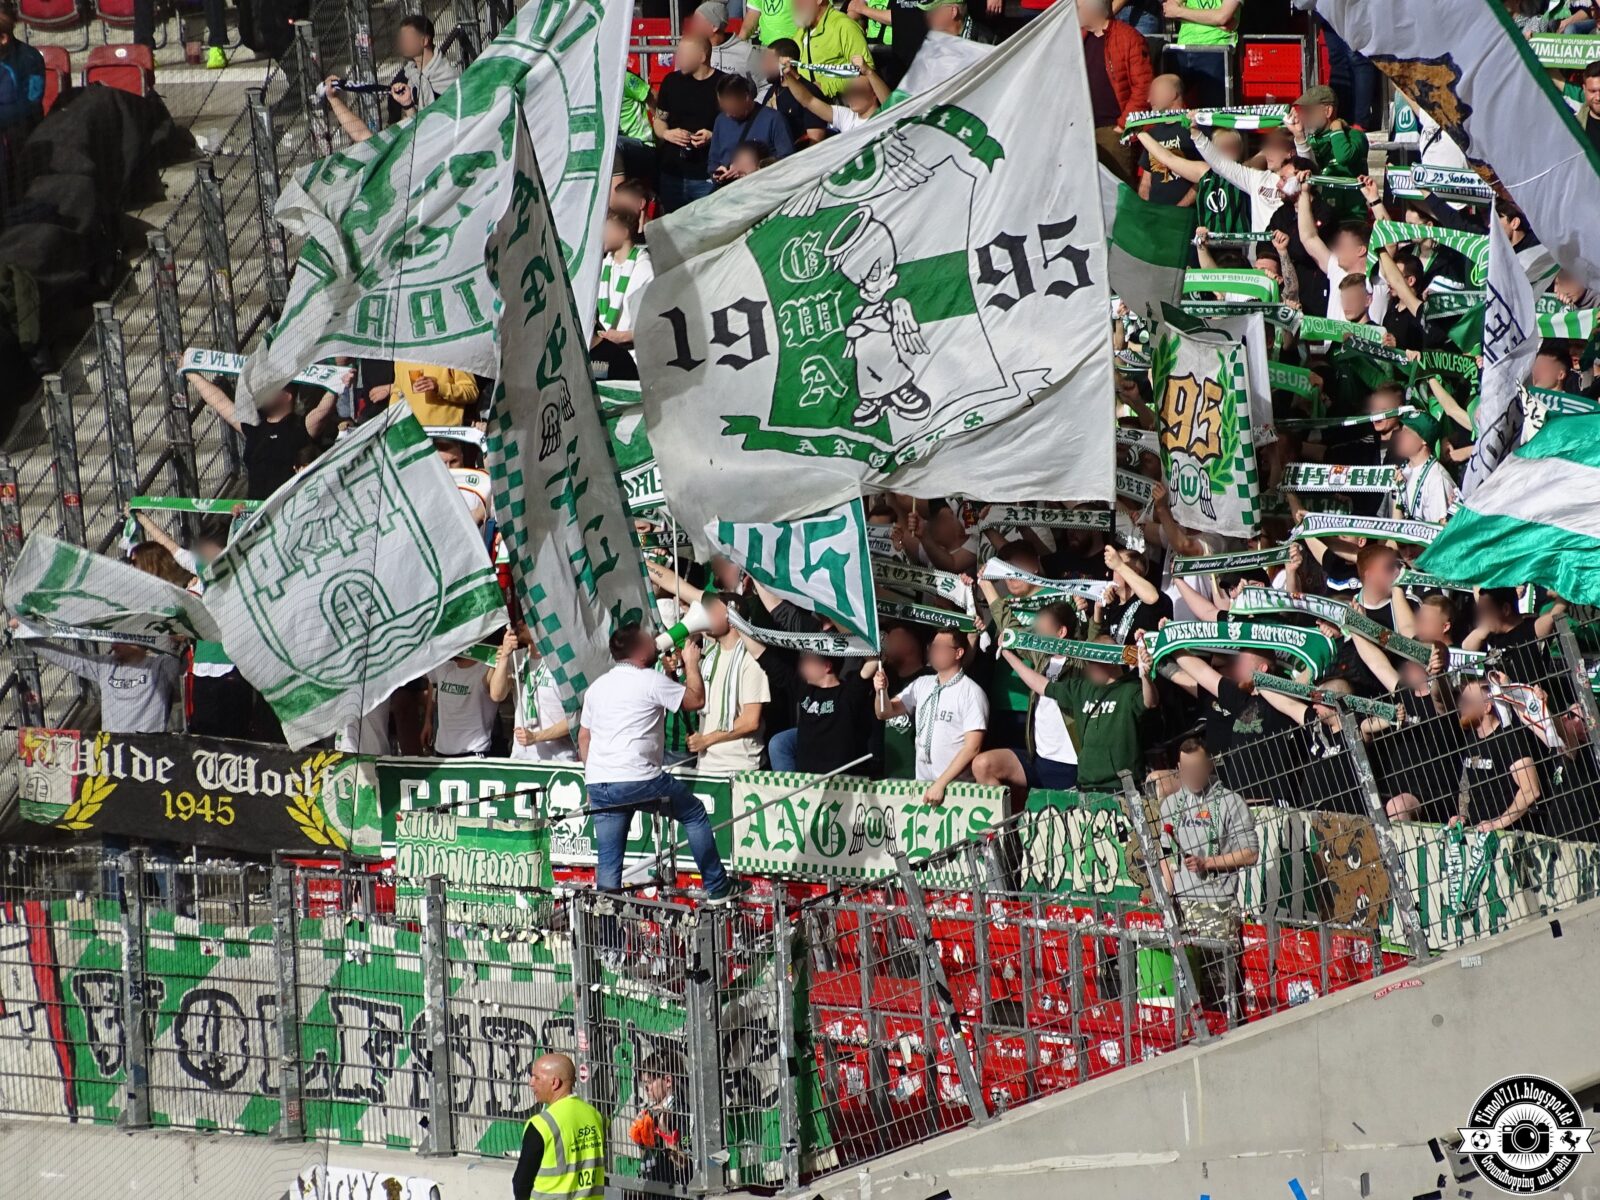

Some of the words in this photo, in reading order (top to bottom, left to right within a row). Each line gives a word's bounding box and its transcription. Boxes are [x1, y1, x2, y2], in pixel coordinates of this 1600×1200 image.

[659, 297, 772, 372] 19
[975, 216, 1095, 312] 95
[1202, 274, 1261, 284] WOLFSBURG
[799, 355, 849, 407] A
[1161, 373, 1223, 464] 95
[1180, 474, 1198, 498] W
[1003, 506, 1112, 527] ANGELS
[1165, 622, 1219, 643] WEEKEND
[1250, 625, 1308, 647] BROTHERS
[35, 736, 175, 785] Wilde
[160, 790, 236, 827] 1945
